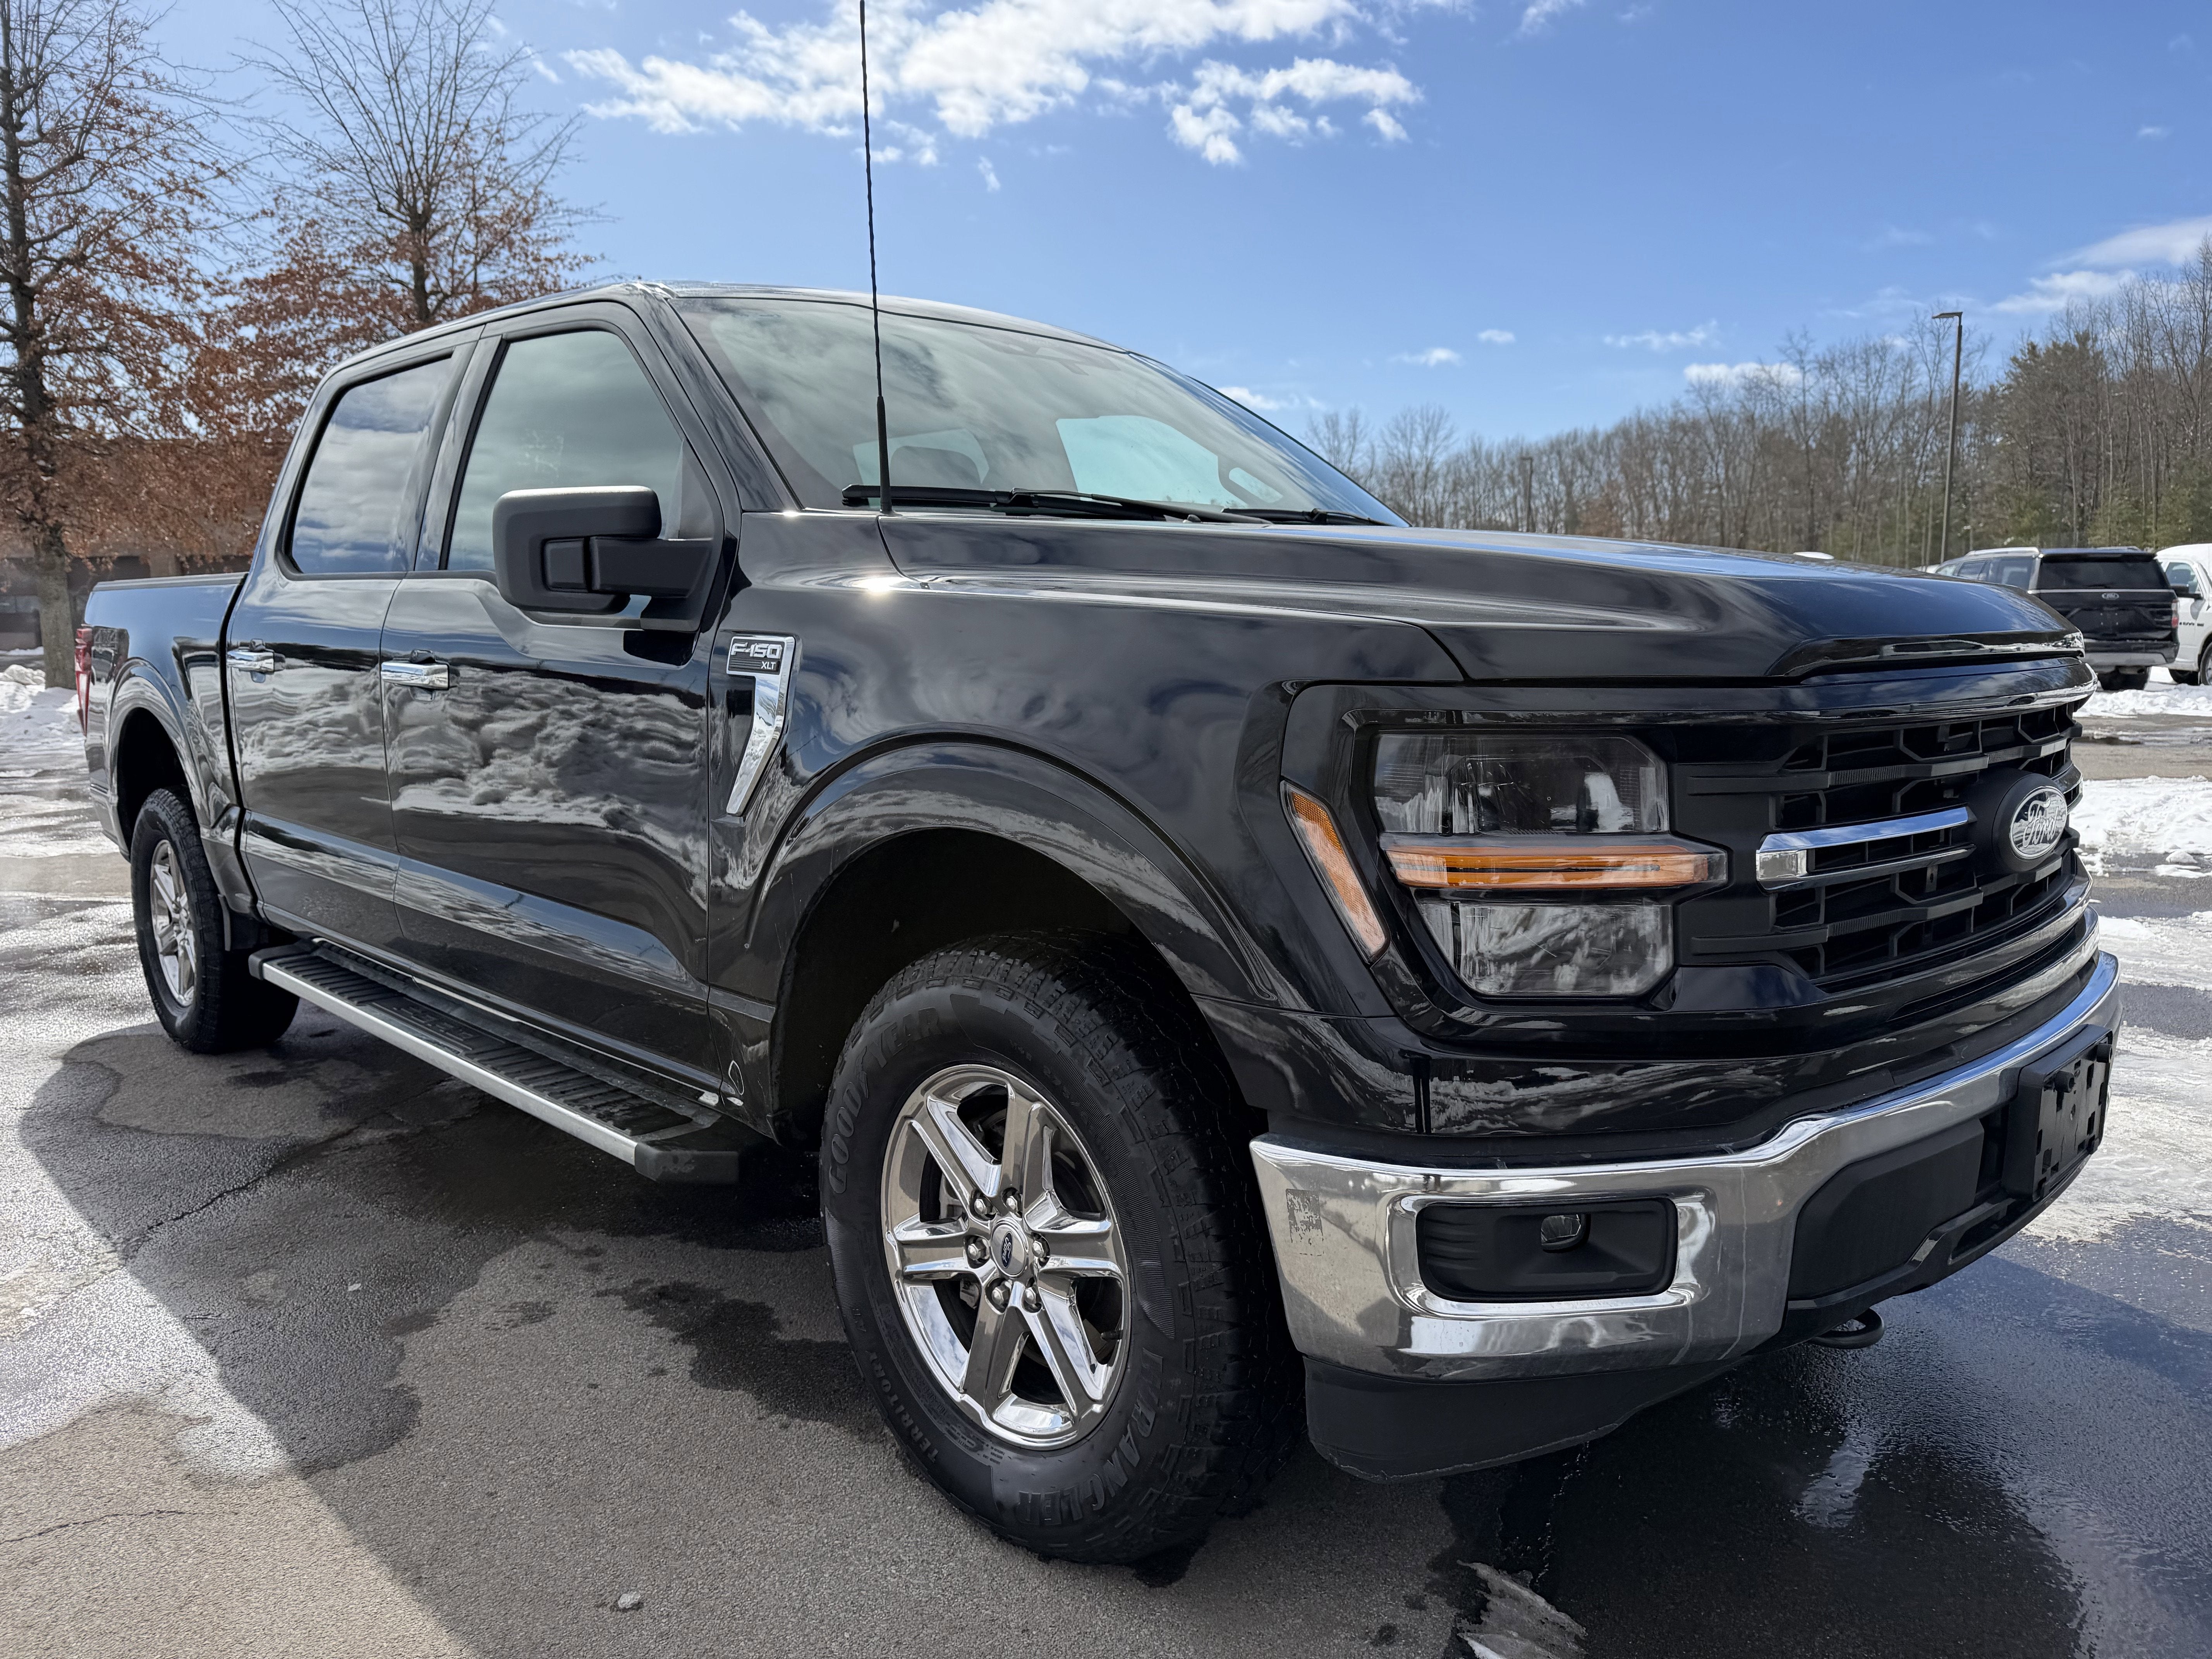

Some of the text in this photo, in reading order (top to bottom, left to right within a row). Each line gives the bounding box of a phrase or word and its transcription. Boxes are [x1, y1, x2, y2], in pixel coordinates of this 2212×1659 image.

[730, 642, 783, 659] F-150
[761, 661, 776, 670] XLT
[2022, 798, 2059, 848] Ford
[1002, 1237, 1012, 1263] Ford
[865, 1350, 939, 1463] TERRITORY
[1016, 1347, 1163, 1525] WRANGLER
